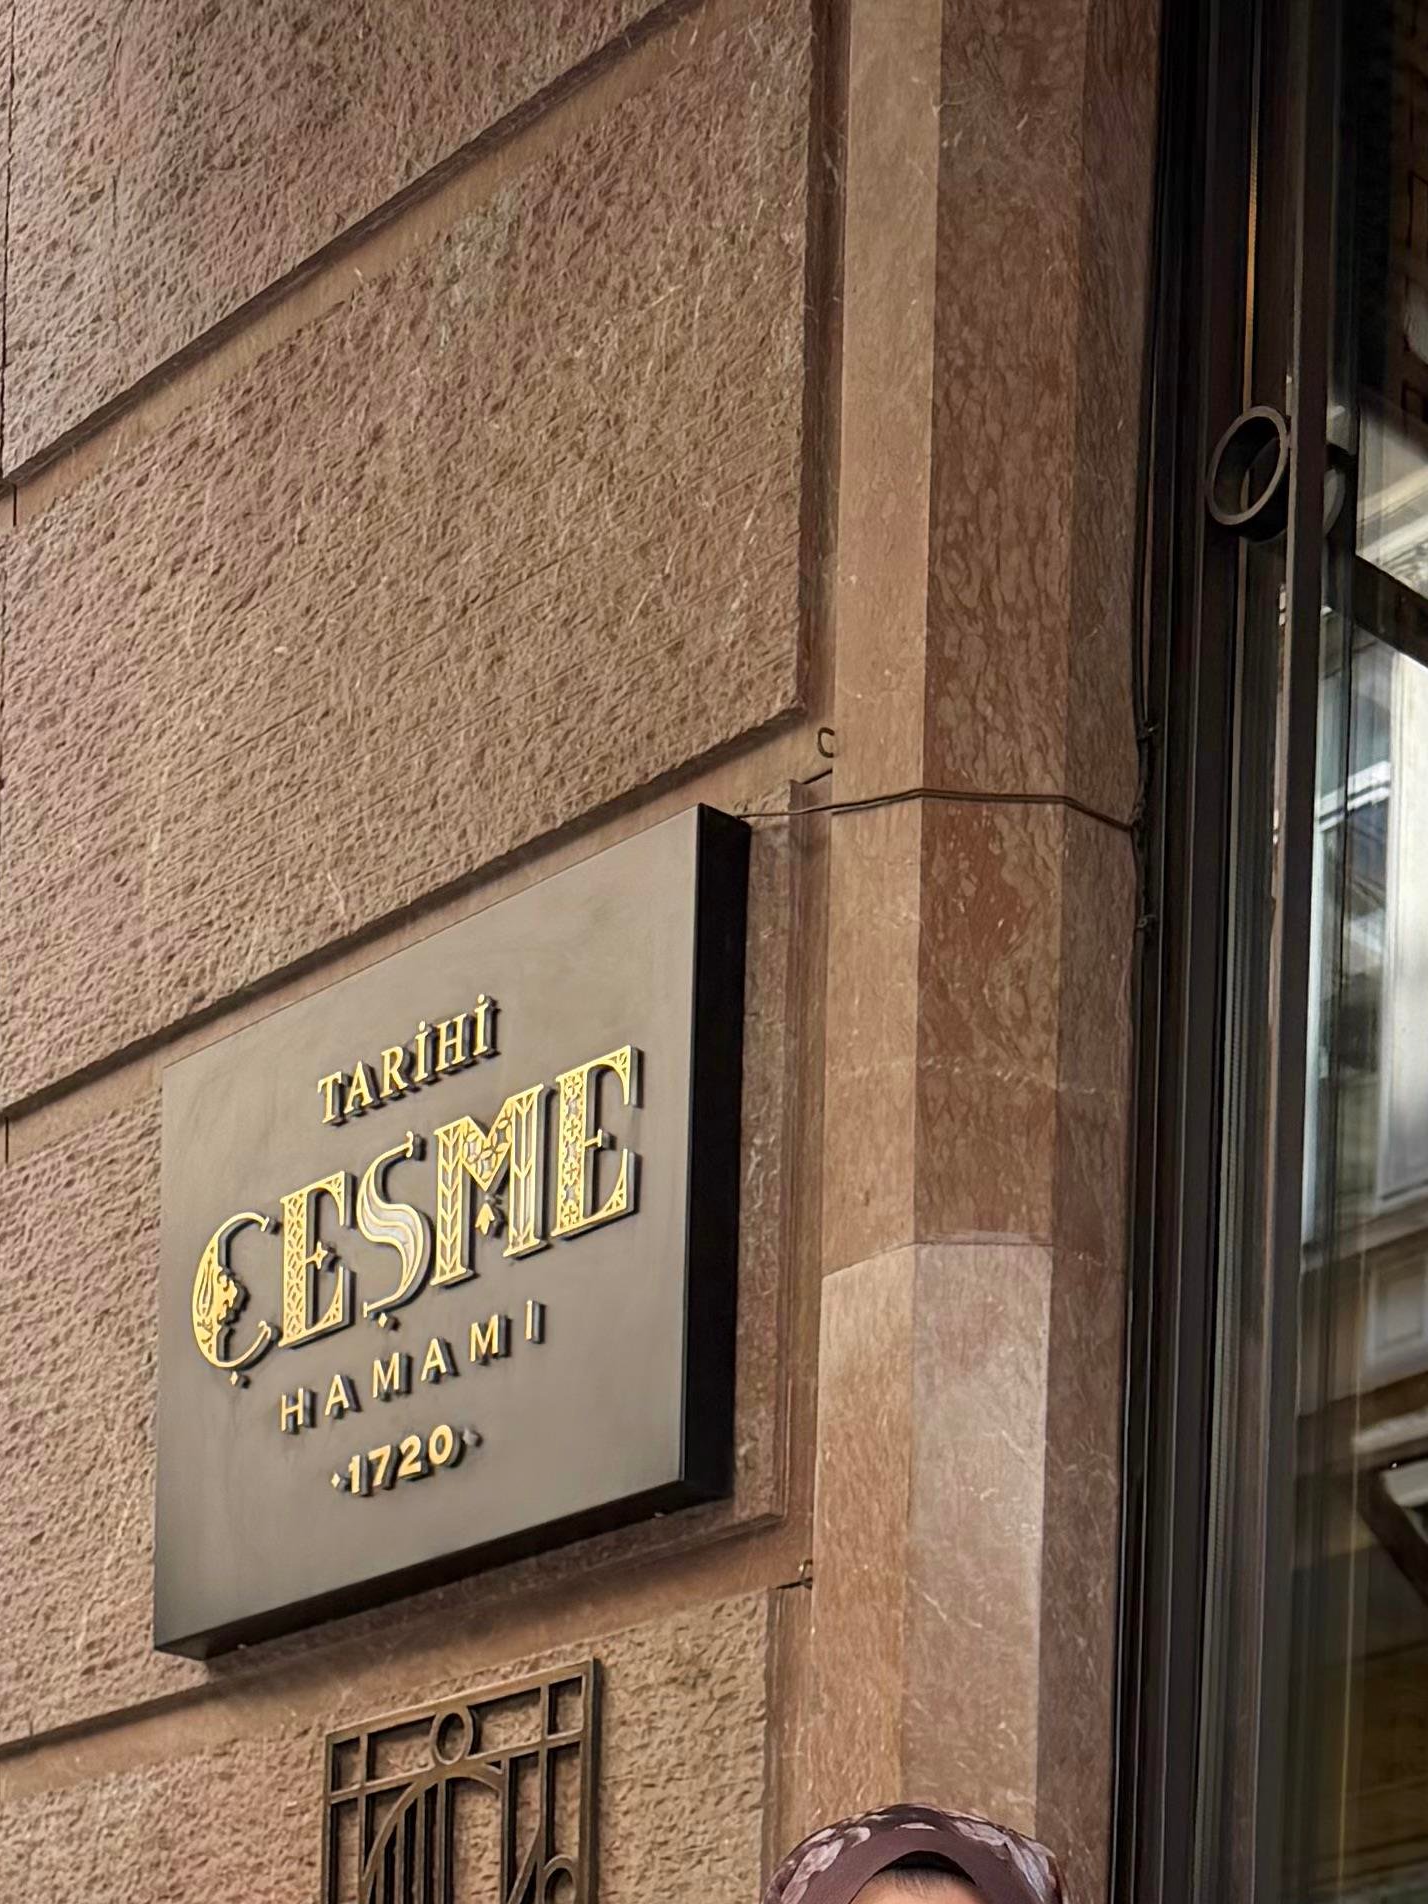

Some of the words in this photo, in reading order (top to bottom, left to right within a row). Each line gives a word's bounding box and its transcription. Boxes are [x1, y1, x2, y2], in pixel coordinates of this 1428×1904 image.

[317, 993, 497, 1124] TARİHİ
[190, 1043, 638, 1386] ÇEŞME
[279, 1299, 544, 1433] HAMAMI
[345, 1422, 458, 1496] 1720
